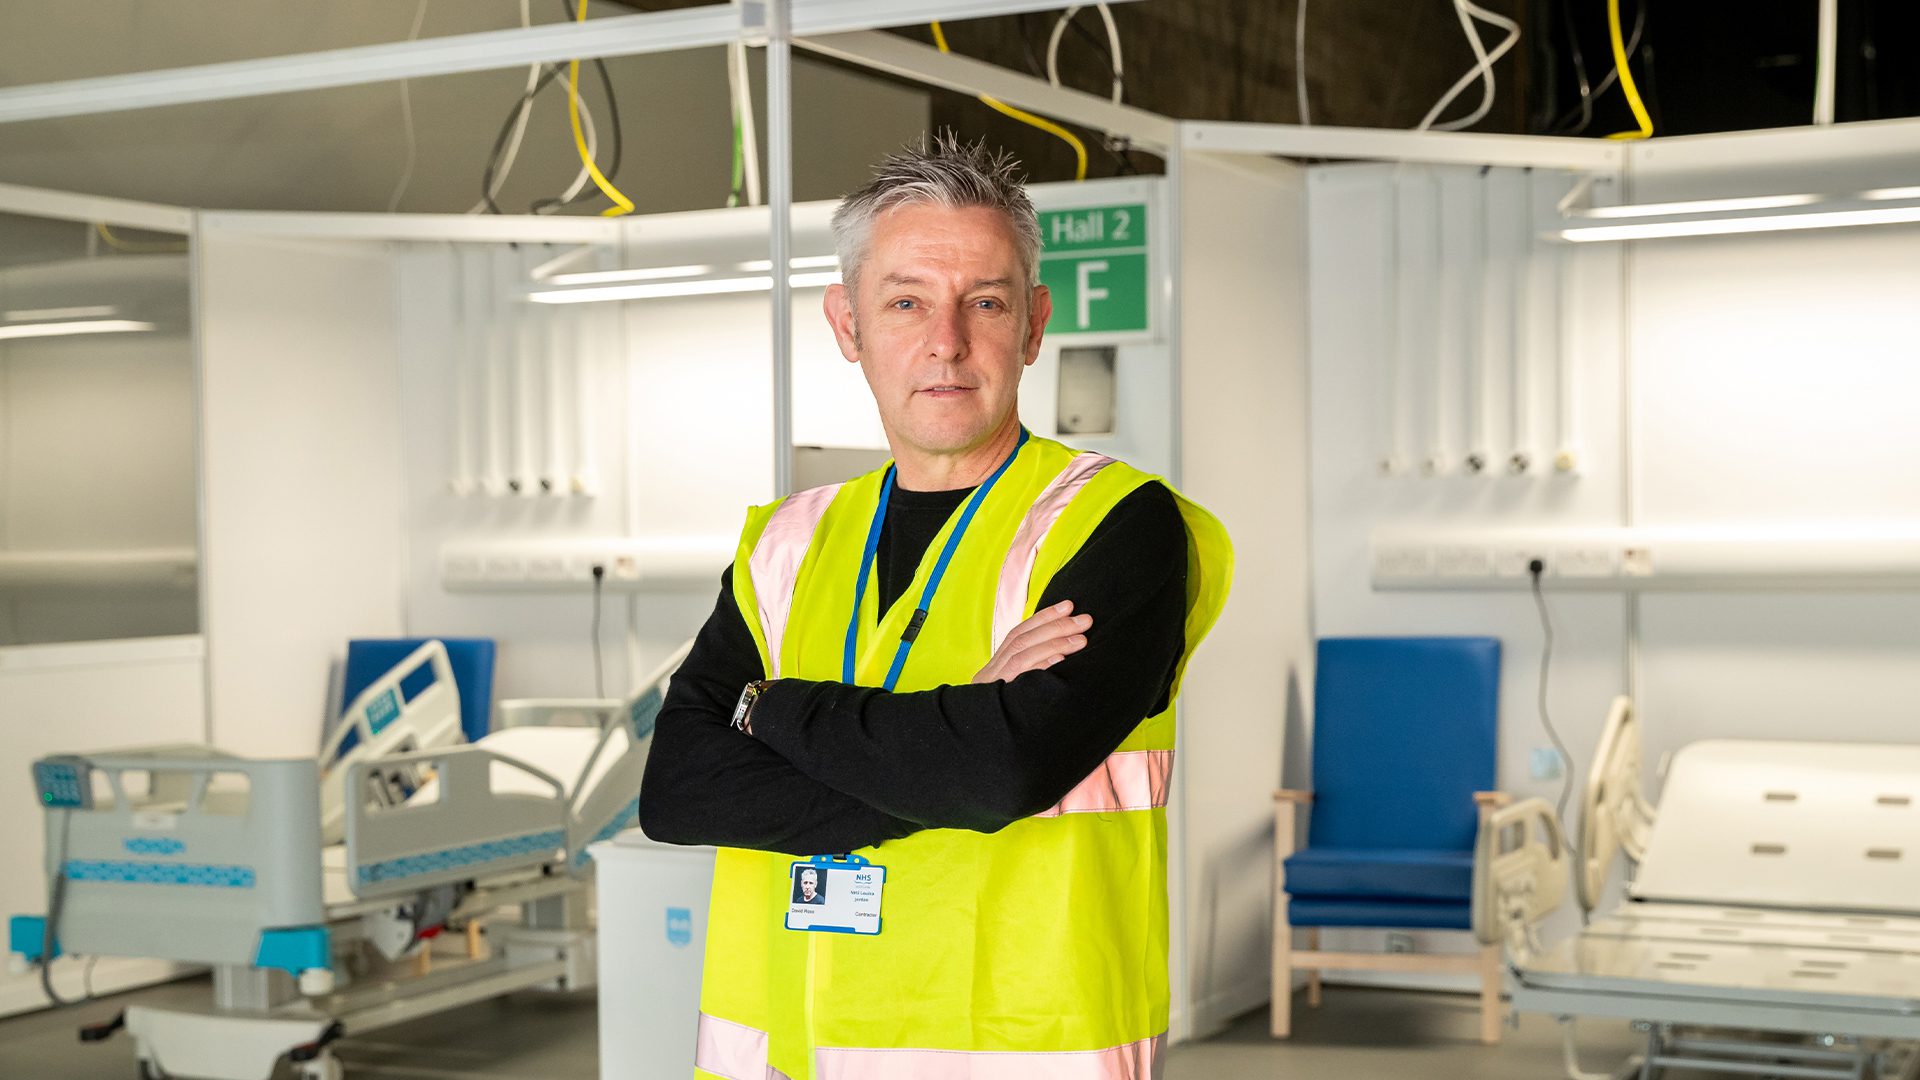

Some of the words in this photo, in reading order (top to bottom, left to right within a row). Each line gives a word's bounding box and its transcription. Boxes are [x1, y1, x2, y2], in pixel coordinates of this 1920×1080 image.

[1051, 209, 1104, 245] Hall
[1111, 209, 1131, 241] 2
[1076, 259, 1109, 330] F
